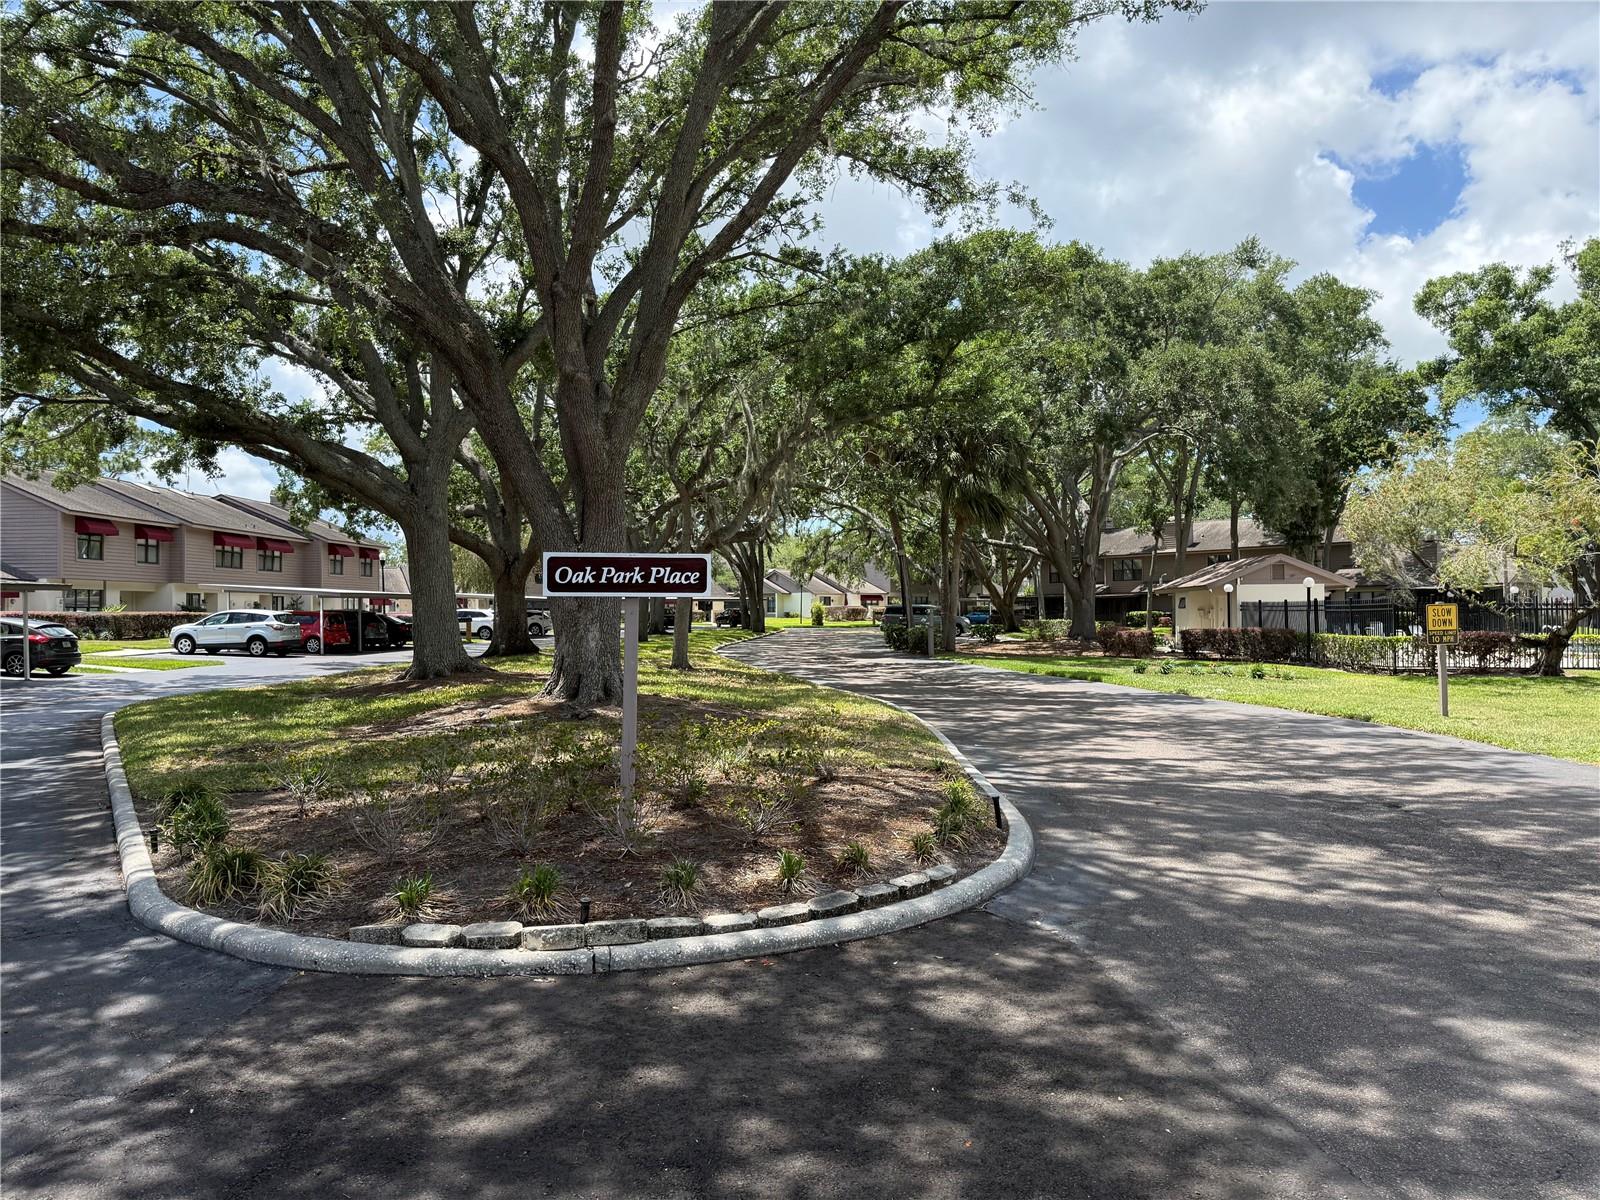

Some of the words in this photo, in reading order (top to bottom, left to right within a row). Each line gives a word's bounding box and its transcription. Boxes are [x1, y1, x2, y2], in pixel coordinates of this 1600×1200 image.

[555, 566, 595, 584] Oak
[599, 566, 645, 584] Park
[649, 566, 700, 584] Place
[1432, 608, 1452, 617] SLOW
[1432, 618, 1453, 628] DOWN
